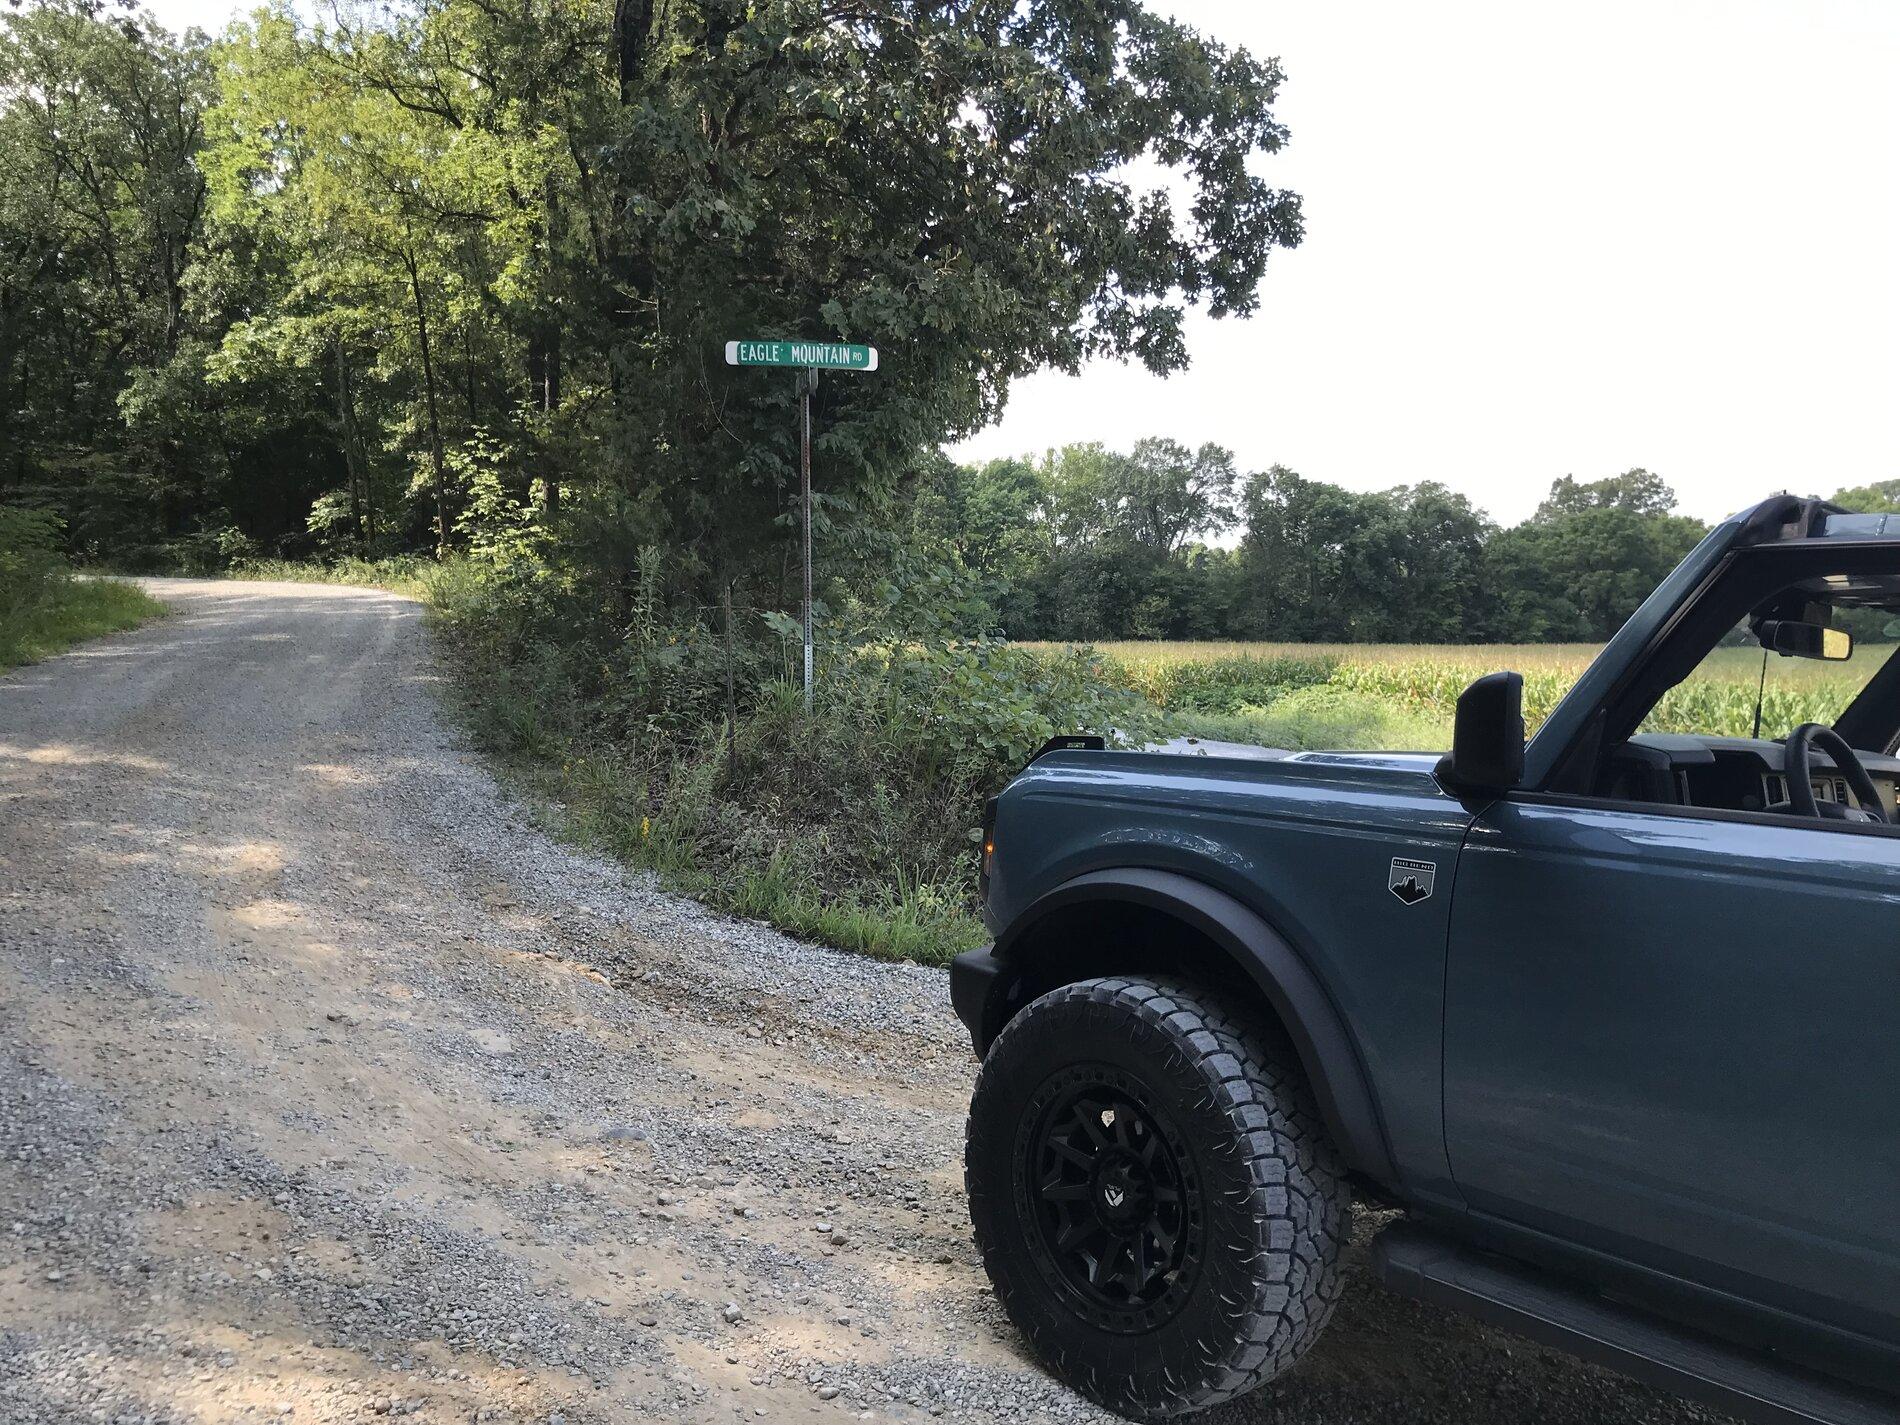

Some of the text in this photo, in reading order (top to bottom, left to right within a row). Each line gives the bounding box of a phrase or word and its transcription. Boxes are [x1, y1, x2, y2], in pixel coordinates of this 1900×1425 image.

[741, 344, 863, 364] EAGLE MOUNTAIN RD
